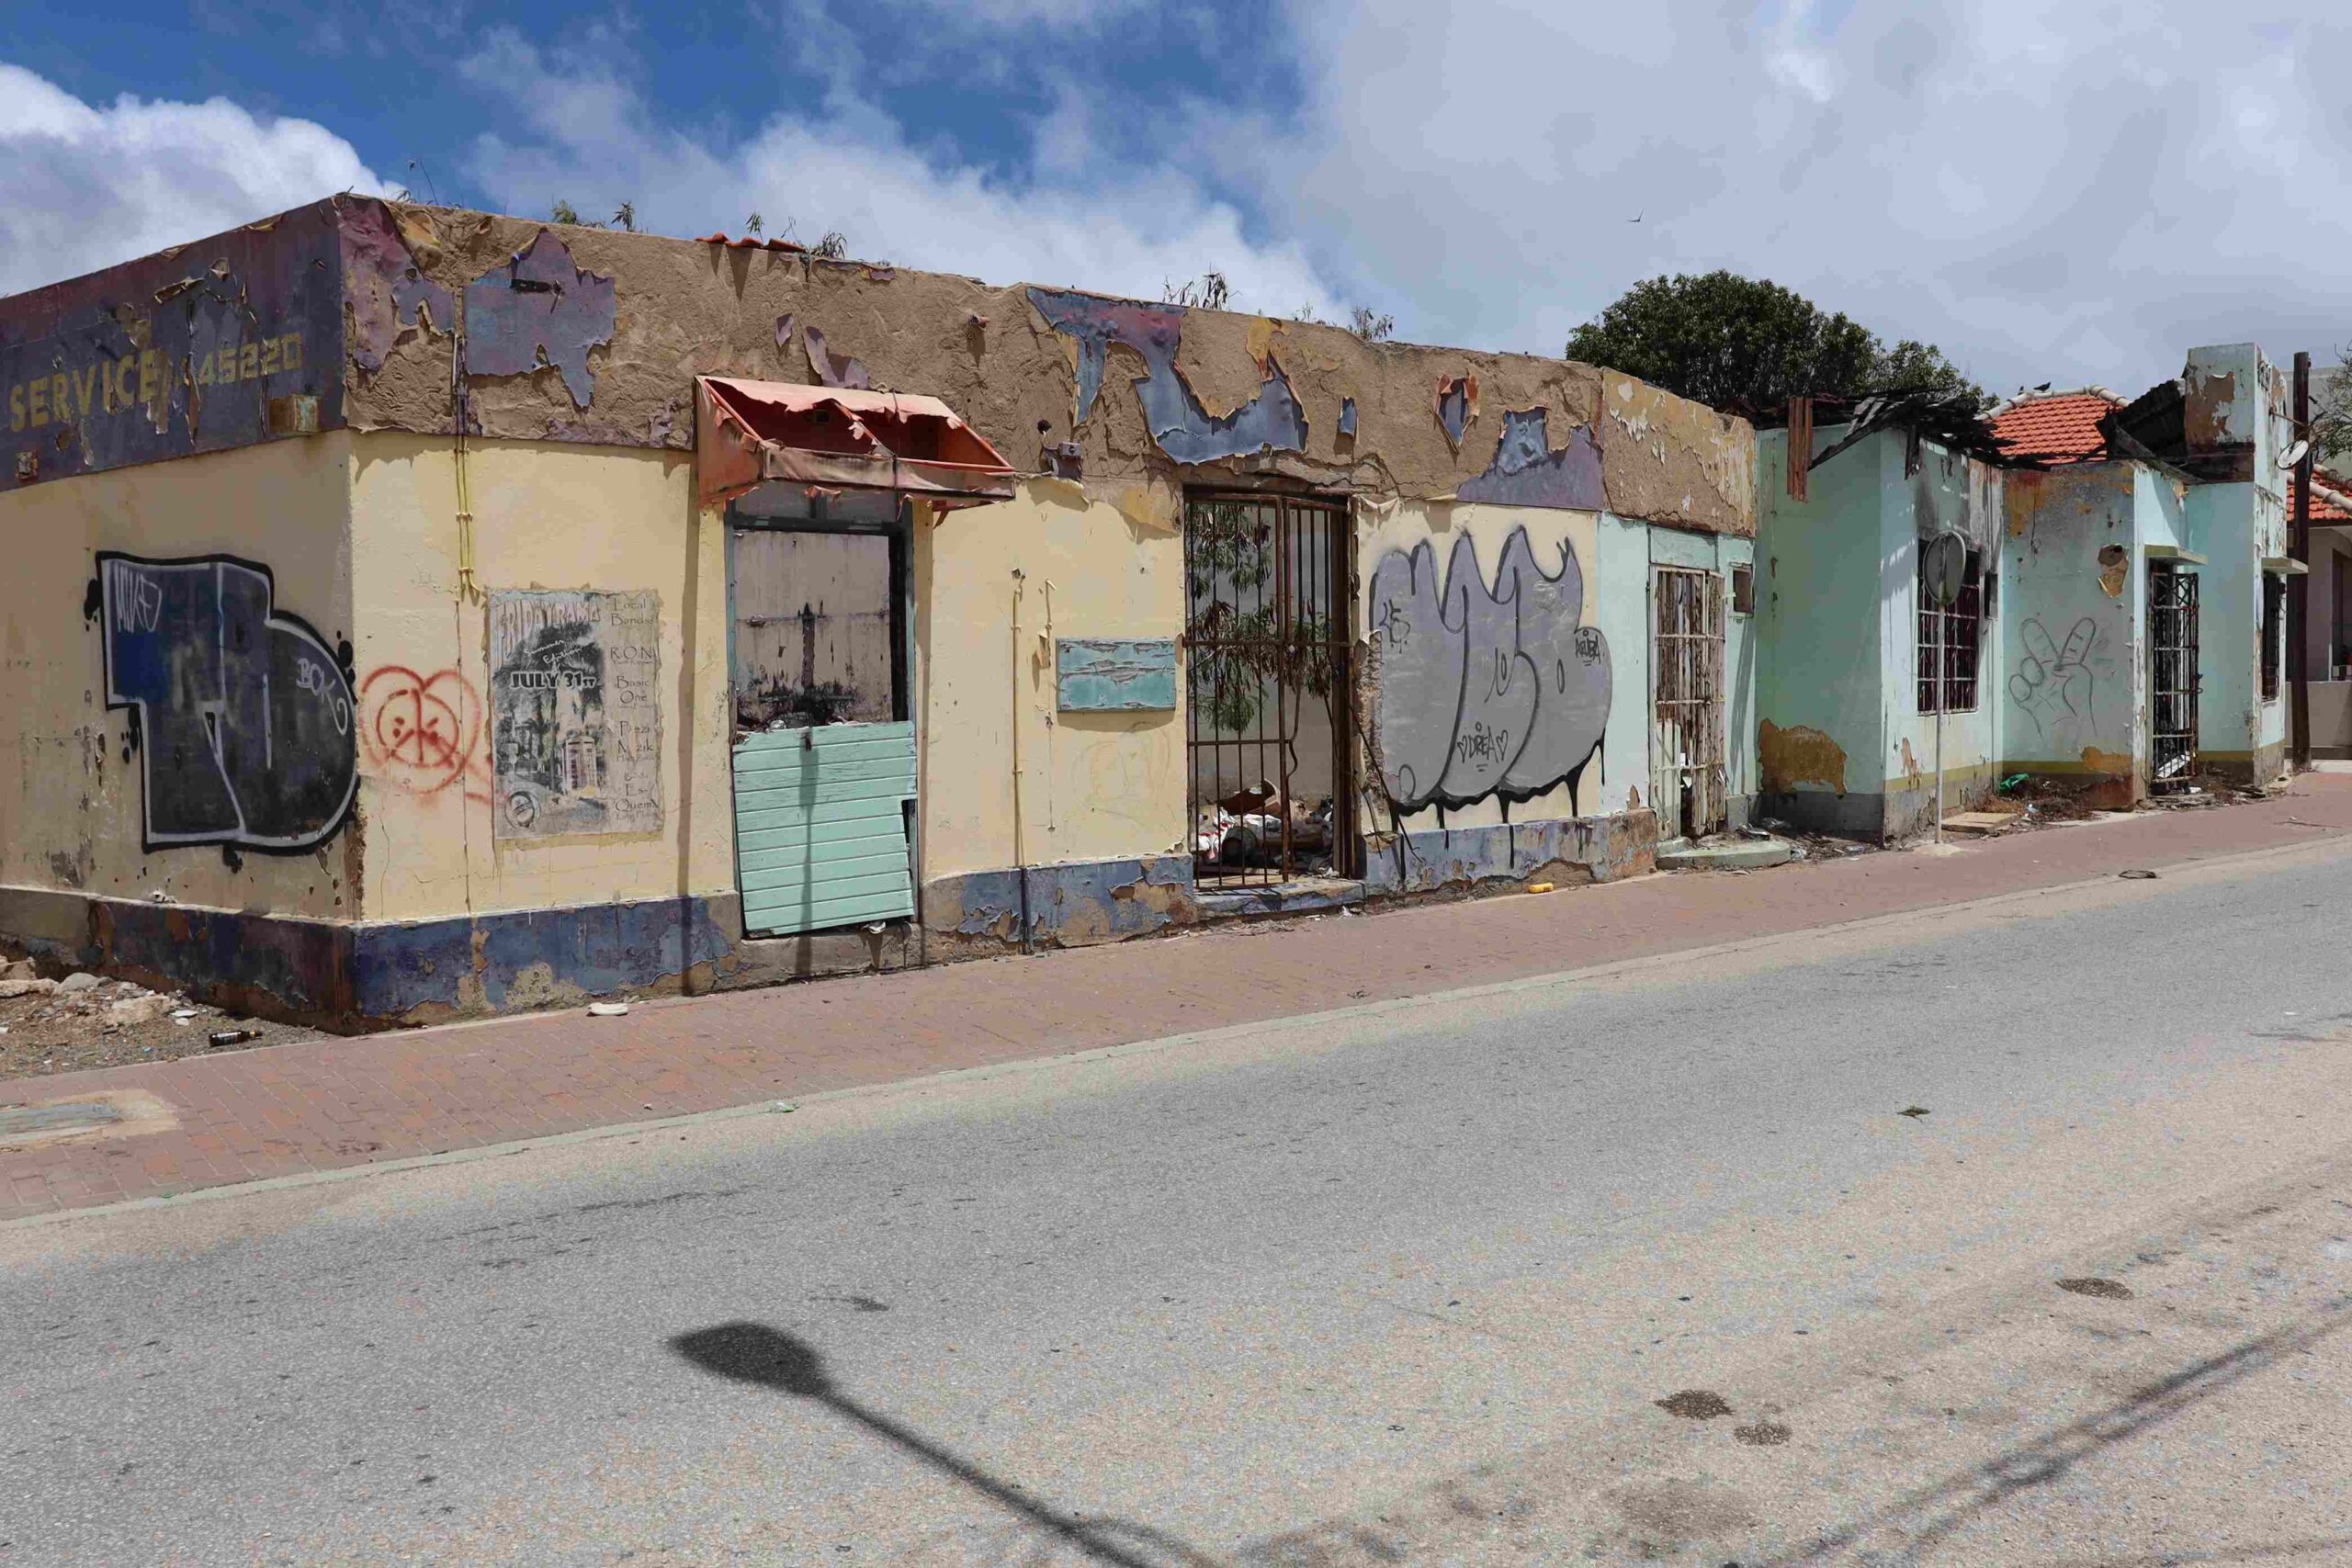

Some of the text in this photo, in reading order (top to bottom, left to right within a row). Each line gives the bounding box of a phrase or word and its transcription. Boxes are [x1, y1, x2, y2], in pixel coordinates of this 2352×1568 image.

[9, 347, 161, 433] SERVICE
[510, 671, 560, 688] JULY
[616, 675, 650, 689] Basic
[620, 690, 647, 704] One
[617, 738, 654, 753] Mzik
[615, 798, 659, 812] Quem
